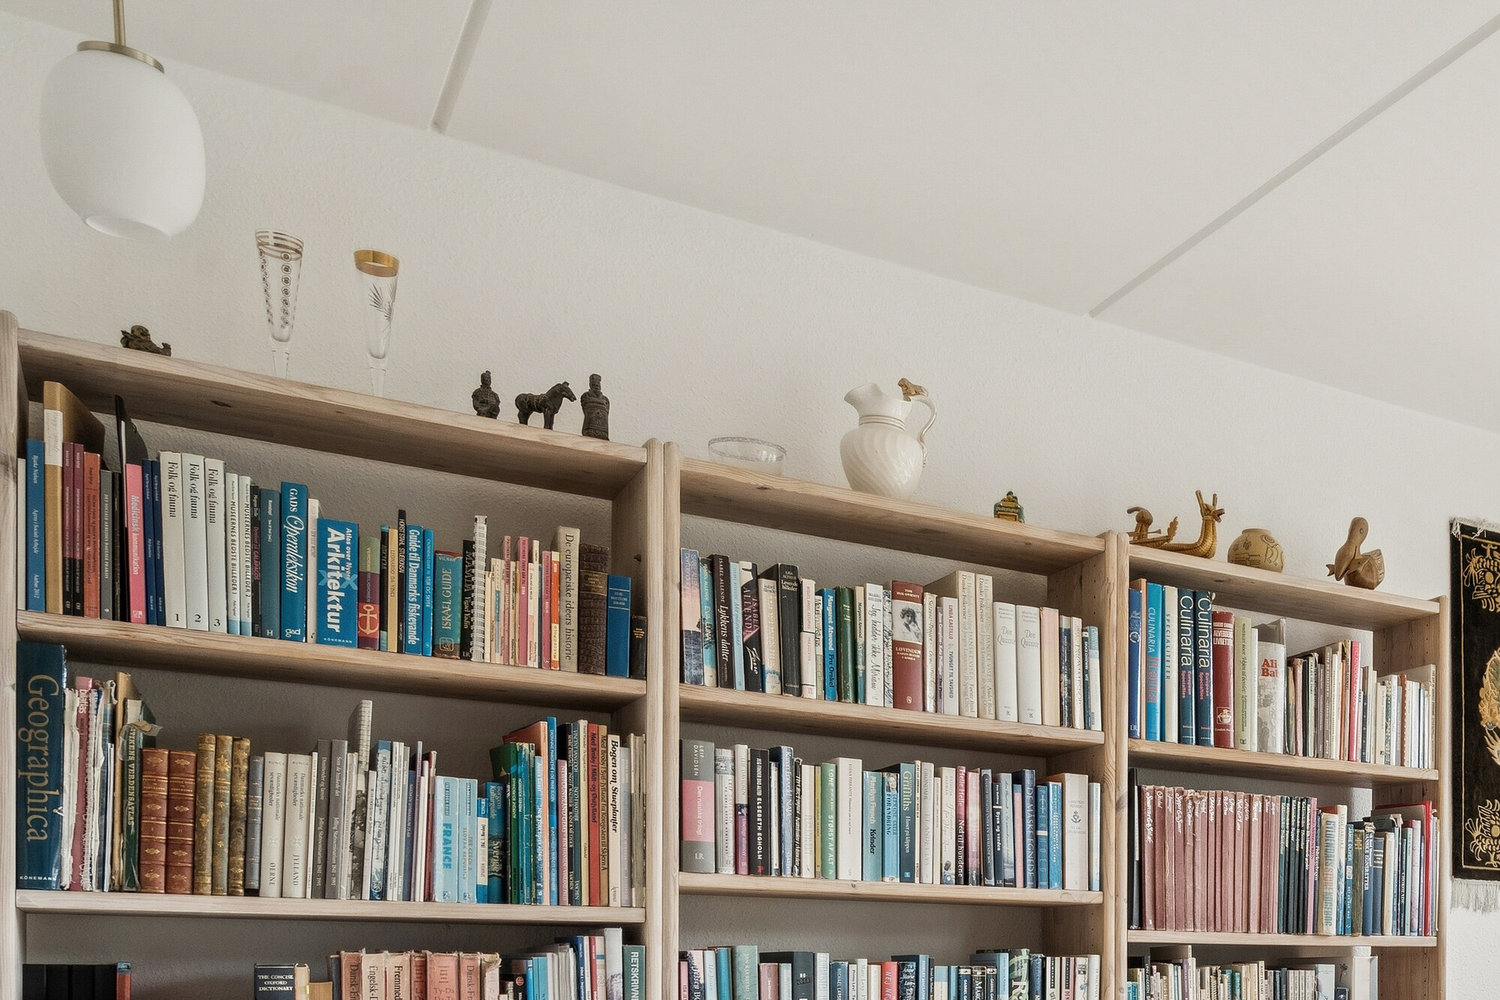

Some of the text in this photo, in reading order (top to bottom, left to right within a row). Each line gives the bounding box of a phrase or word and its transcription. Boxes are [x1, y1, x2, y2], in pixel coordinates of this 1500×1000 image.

[168, 461, 179, 518] Folk og fauna
[189, 463, 200, 519] Folk og fauna
[208, 468, 219, 524] Folk og fauna
[131, 495, 141, 575] Medicinsk kommunikation
[230, 501, 239, 591] MUSEERNES BEDSTE BILLEDER
[244, 503, 252, 540] MUSEERNES
[283, 488, 305, 593] GADS Operaleksikon
[345, 528, 353, 560] Atlas over
[327, 527, 345, 632] Arkitektur
[408, 530, 421, 645] Guide til Danmarks fiskevande
[464, 550, 473, 592] MASADA
[562, 534, 575, 660] De europæiske ideers historie
[195, 614, 201, 622] 2
[214, 619, 221, 627] 3
[441, 568, 452, 630] ISRAEL GUIDE
[717, 605, 729, 637] Lykkens
[743, 587, 752, 636] ALLENDE
[751, 597, 759, 630] ISABEL
[826, 594, 834, 624] Margaret
[721, 639, 730, 662] datter
[868, 604, 881, 657] Jeg ikke
[1147, 607, 1161, 703] CULINARIA Italia
[1180, 595, 1194, 667] Culinaria
[1197, 597, 1211, 669] Culinaria
[1262, 658, 1278, 668] Ali
[17, 674, 60, 842] Geographica
[590, 732, 599, 824] Med Broby Østjylland
[127, 763, 136, 826] VERDENSATLAS
[489, 785, 497, 820] Kulturguide
[495, 785, 503, 810] Borgens
[609, 740, 619, 833] Bogen om Stueplanter
[903, 770, 912, 811] Griffiths
[442, 822, 452, 869] FRANCE
[490, 840, 502, 873] Sverige
[869, 828, 877, 855] Kvinder
[1026, 803, 1035, 876] MÅSKE EGNEDE
[292, 854, 300, 886] JYLLAND
